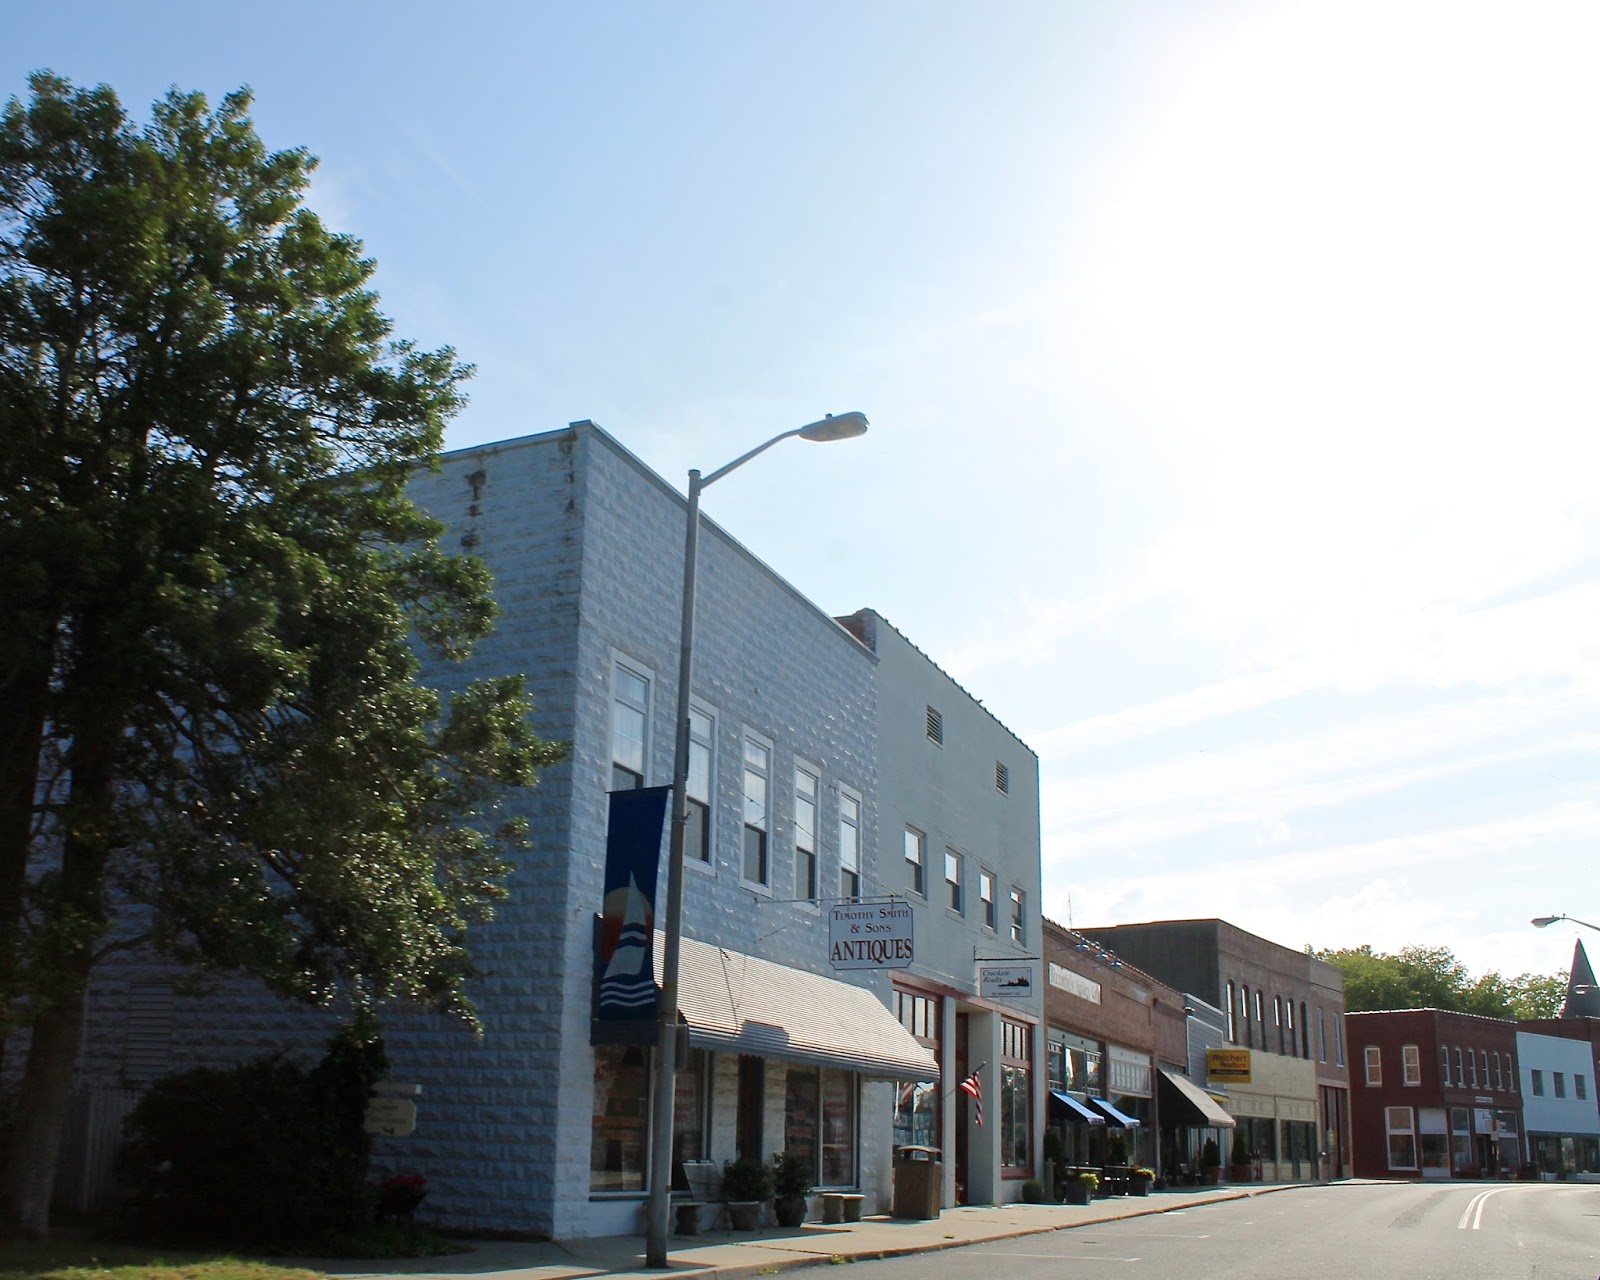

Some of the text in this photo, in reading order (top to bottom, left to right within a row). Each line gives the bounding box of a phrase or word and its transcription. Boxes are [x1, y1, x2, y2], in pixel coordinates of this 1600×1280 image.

[833, 908, 909, 920] TIMOTHY SMITH
[850, 922, 892, 934] & SONS
[831, 938, 912, 964] ANTIQUES
